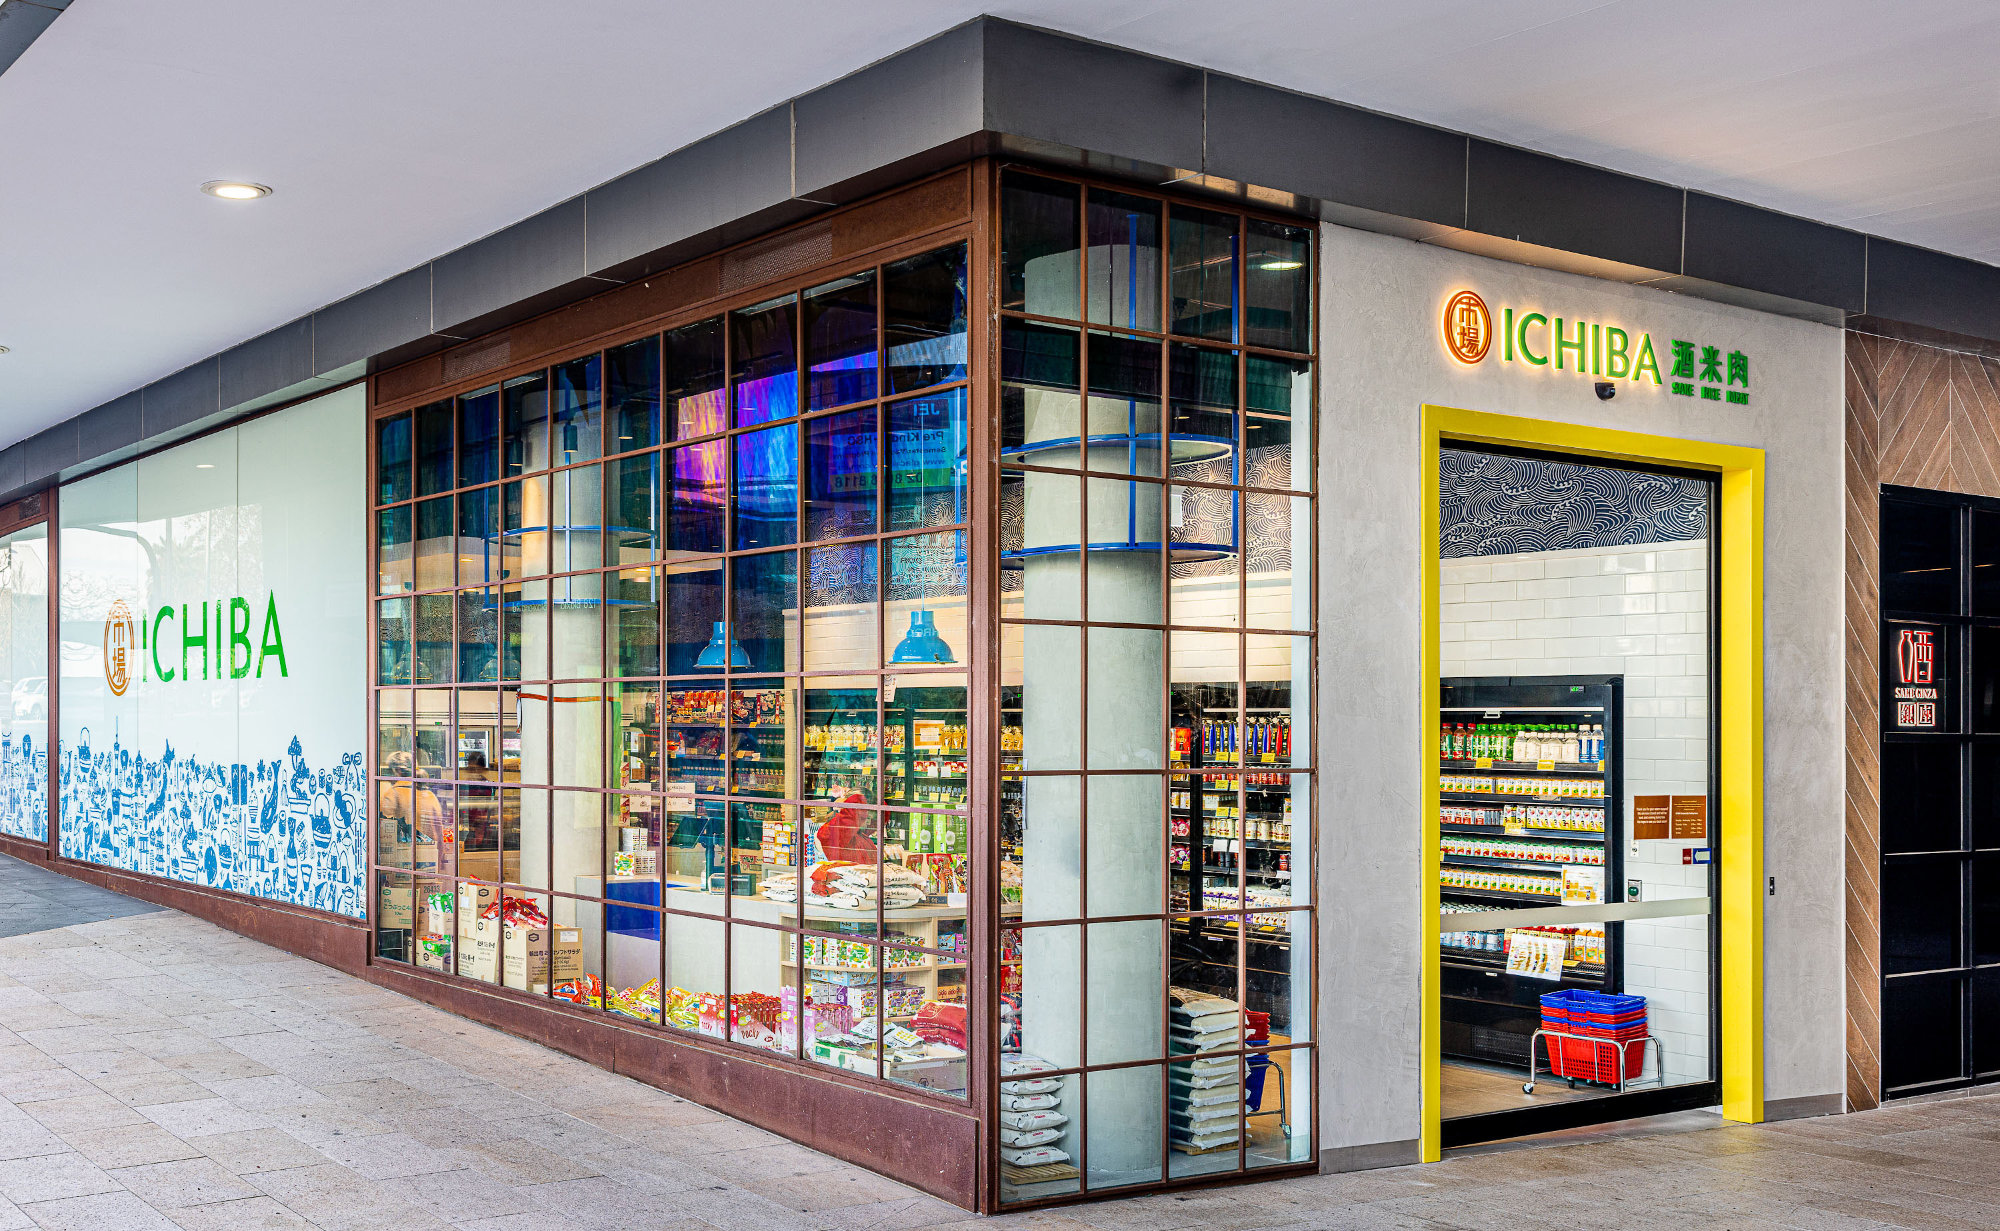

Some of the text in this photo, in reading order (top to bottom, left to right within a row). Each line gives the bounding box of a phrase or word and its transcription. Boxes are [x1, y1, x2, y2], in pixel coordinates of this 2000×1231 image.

[1503, 308, 1663, 385] ICHIBA
[1671, 382, 1749, 405] SAKE RICE MEAT
[142, 589, 288, 683] ICHIBA
[1894, 687, 1915, 699] SAKE
